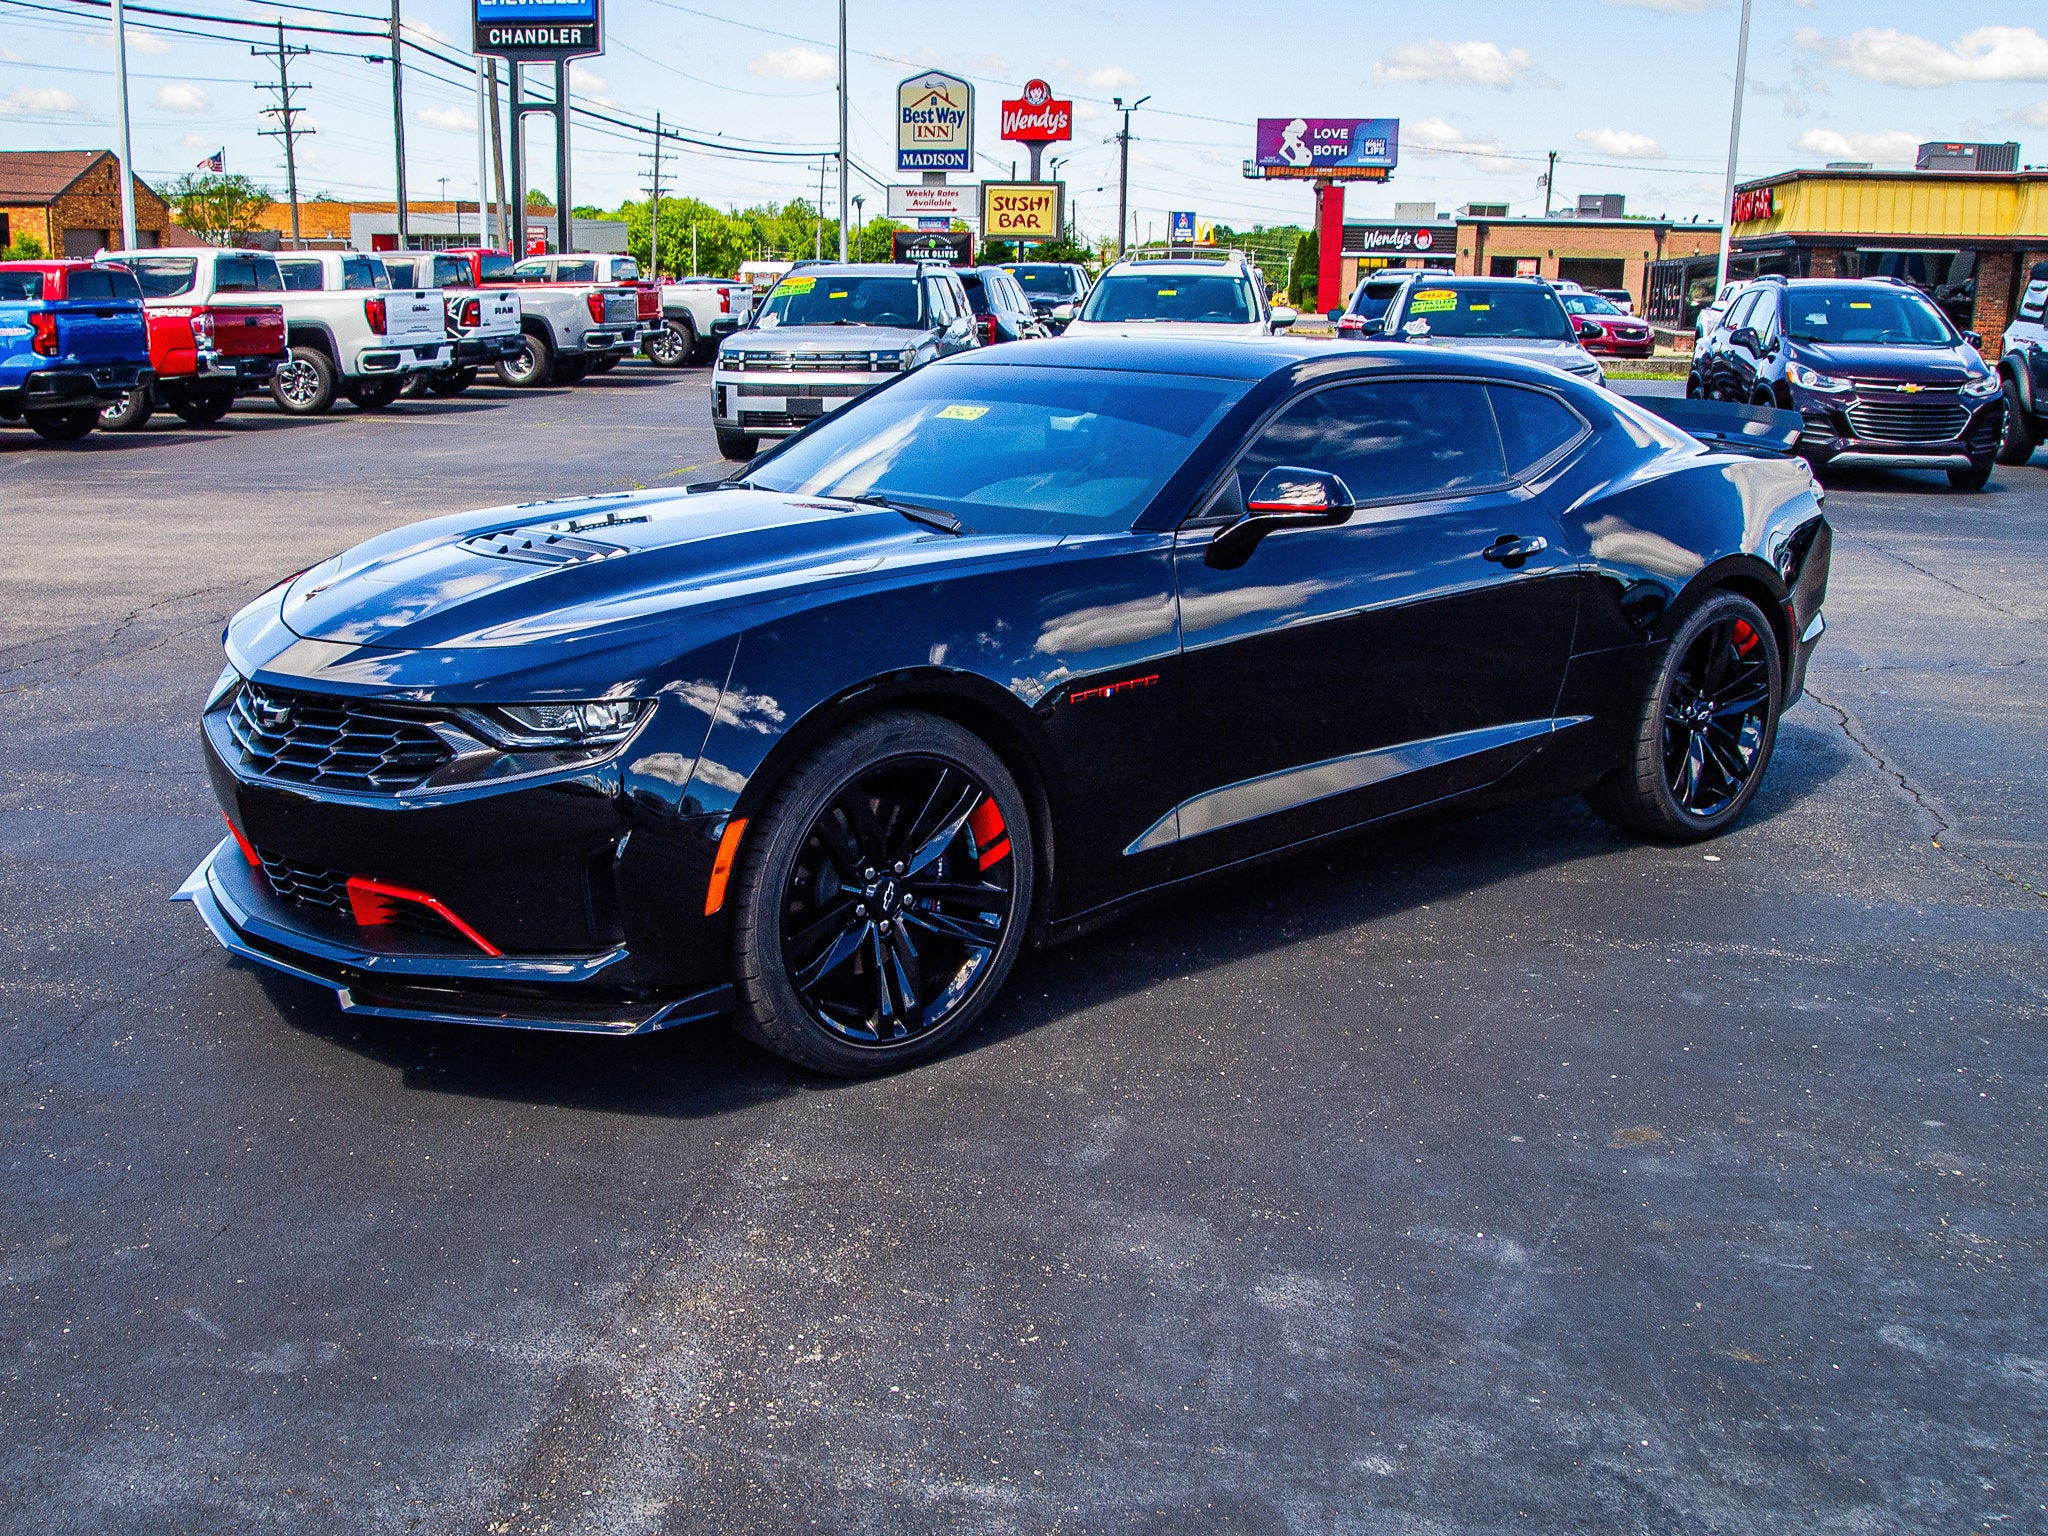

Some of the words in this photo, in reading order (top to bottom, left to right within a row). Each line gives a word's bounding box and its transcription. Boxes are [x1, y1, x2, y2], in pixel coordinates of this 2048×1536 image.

[489, 28, 581, 44] CHANDLER
[902, 107, 934, 124] Best
[936, 107, 965, 129] Way
[1003, 105, 1068, 134] Wendy's
[917, 125, 950, 138] INN
[1314, 128, 1348, 139] LOVE
[1313, 145, 1348, 156] BOTH
[901, 153, 964, 166] MADISON
[905, 189, 935, 199] Weekly
[937, 189, 959, 198] Rates
[912, 199, 952, 207] Available
[992, 196, 1050, 211] SUSHI
[999, 213, 1041, 228] BAR
[1364, 228, 1412, 250] Wendy's
[905, 250, 929, 259] BLACK
[932, 249, 959, 259] OLIVES
[494, 306, 514, 315] RAM
